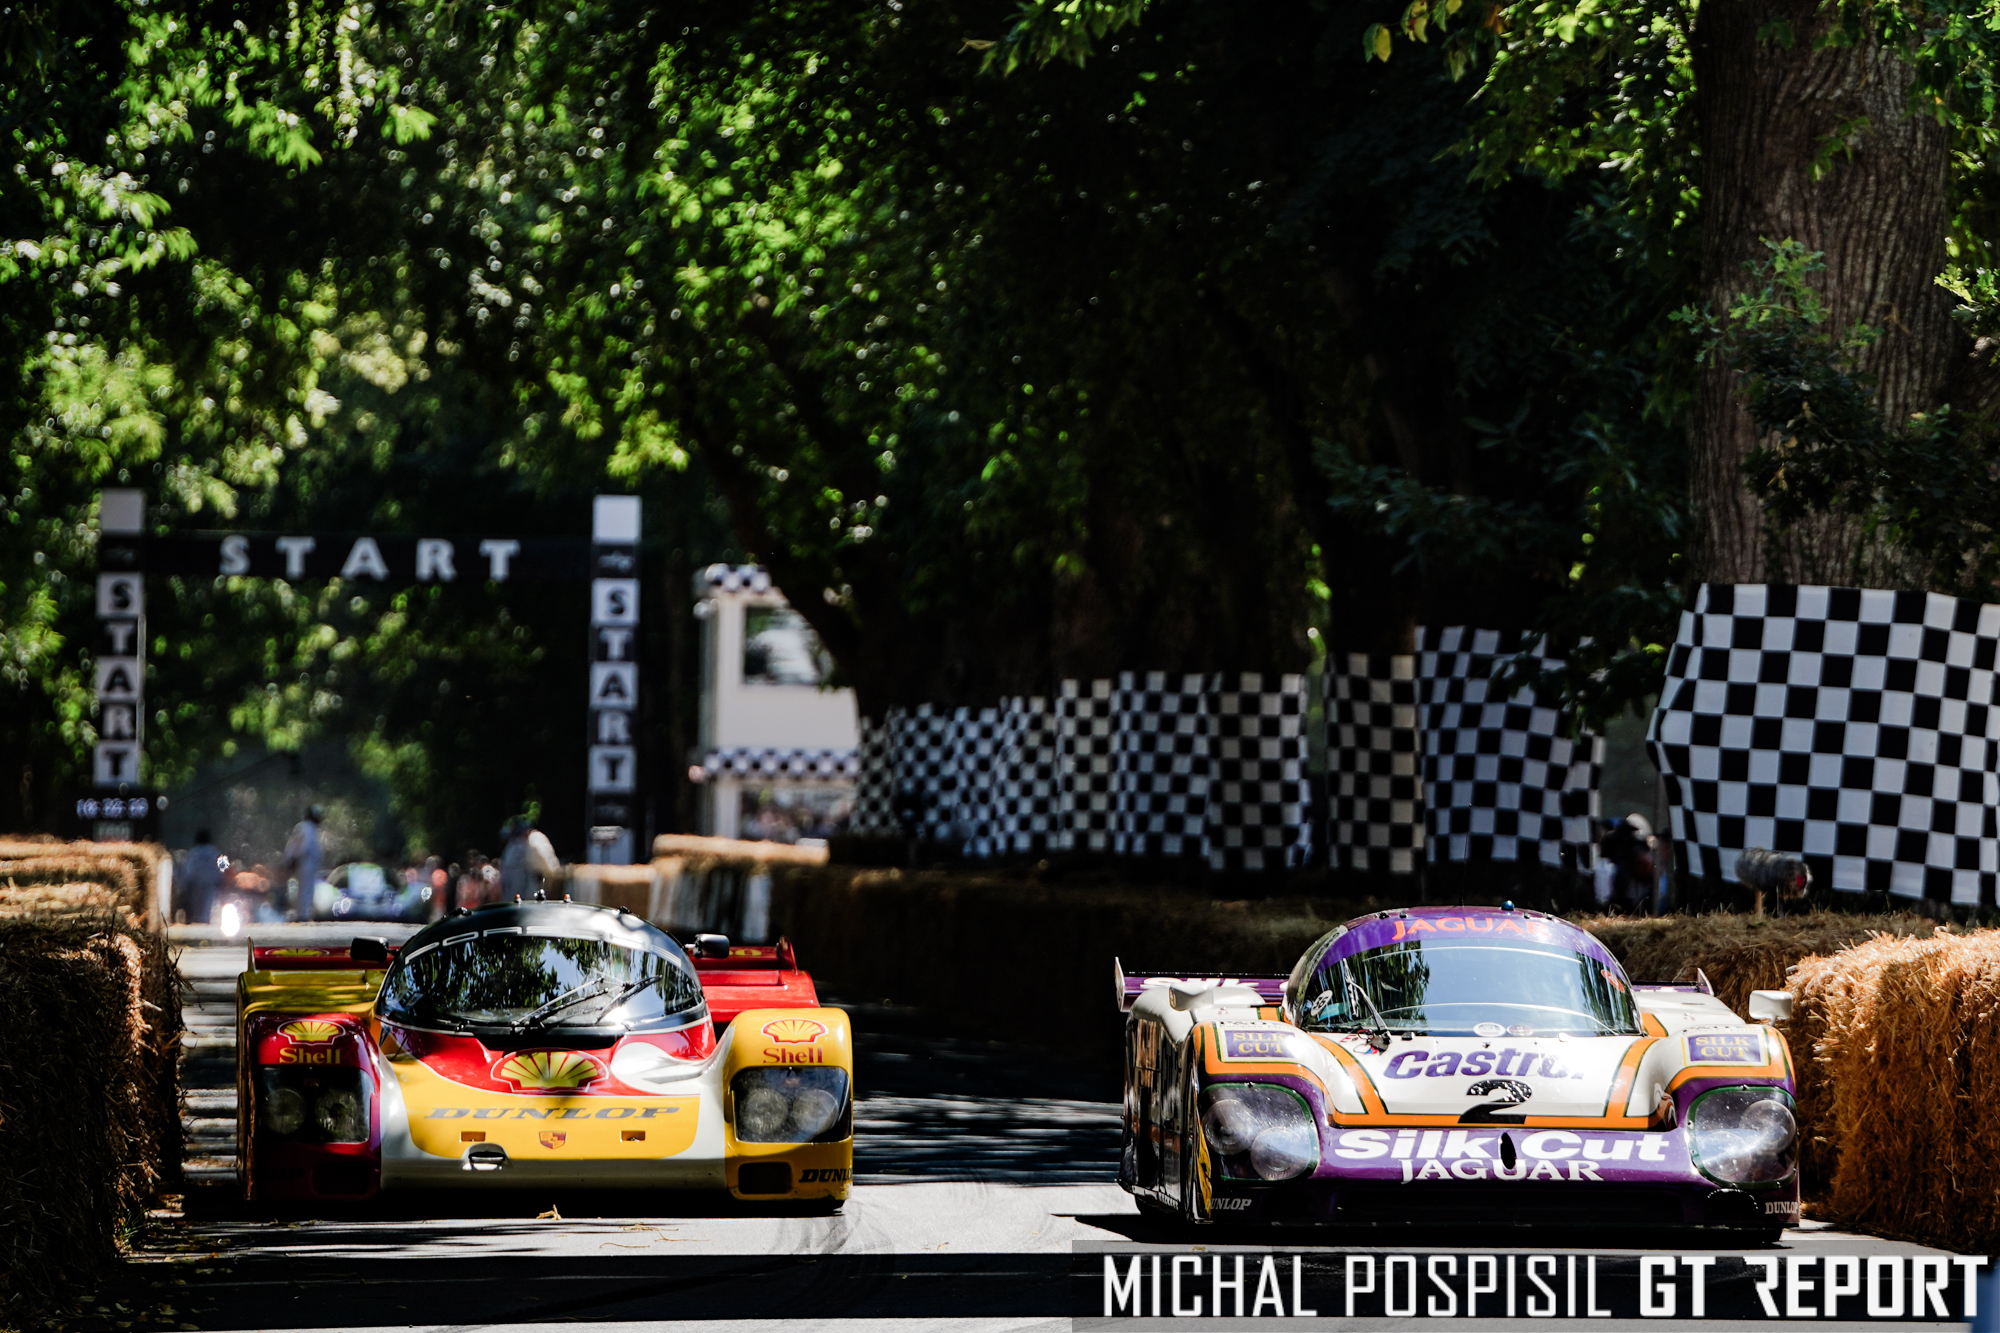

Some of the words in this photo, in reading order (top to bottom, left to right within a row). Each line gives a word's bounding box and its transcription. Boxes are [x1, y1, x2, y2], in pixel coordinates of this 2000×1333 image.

[218, 536, 521, 582] START
[104, 578, 136, 778] START
[599, 588, 634, 782] START
[1392, 917, 1550, 941] JAGUAR
[1233, 1032, 1286, 1041] SILK
[1238, 1043, 1286, 1053] CUT
[1695, 1036, 1750, 1046] SILK
[279, 1047, 341, 1065] Shell
[763, 1047, 823, 1064] Shell
[1383, 1048, 1584, 1079] Castro
[1700, 1047, 1748, 1057] CUT
[424, 1107, 681, 1120] DUNLOP
[1458, 1079, 1533, 1124] 2
[1335, 1130, 1494, 1159] Silk
[1521, 1131, 1670, 1161] Cut
[1398, 1159, 1605, 1184] JAGUAR
